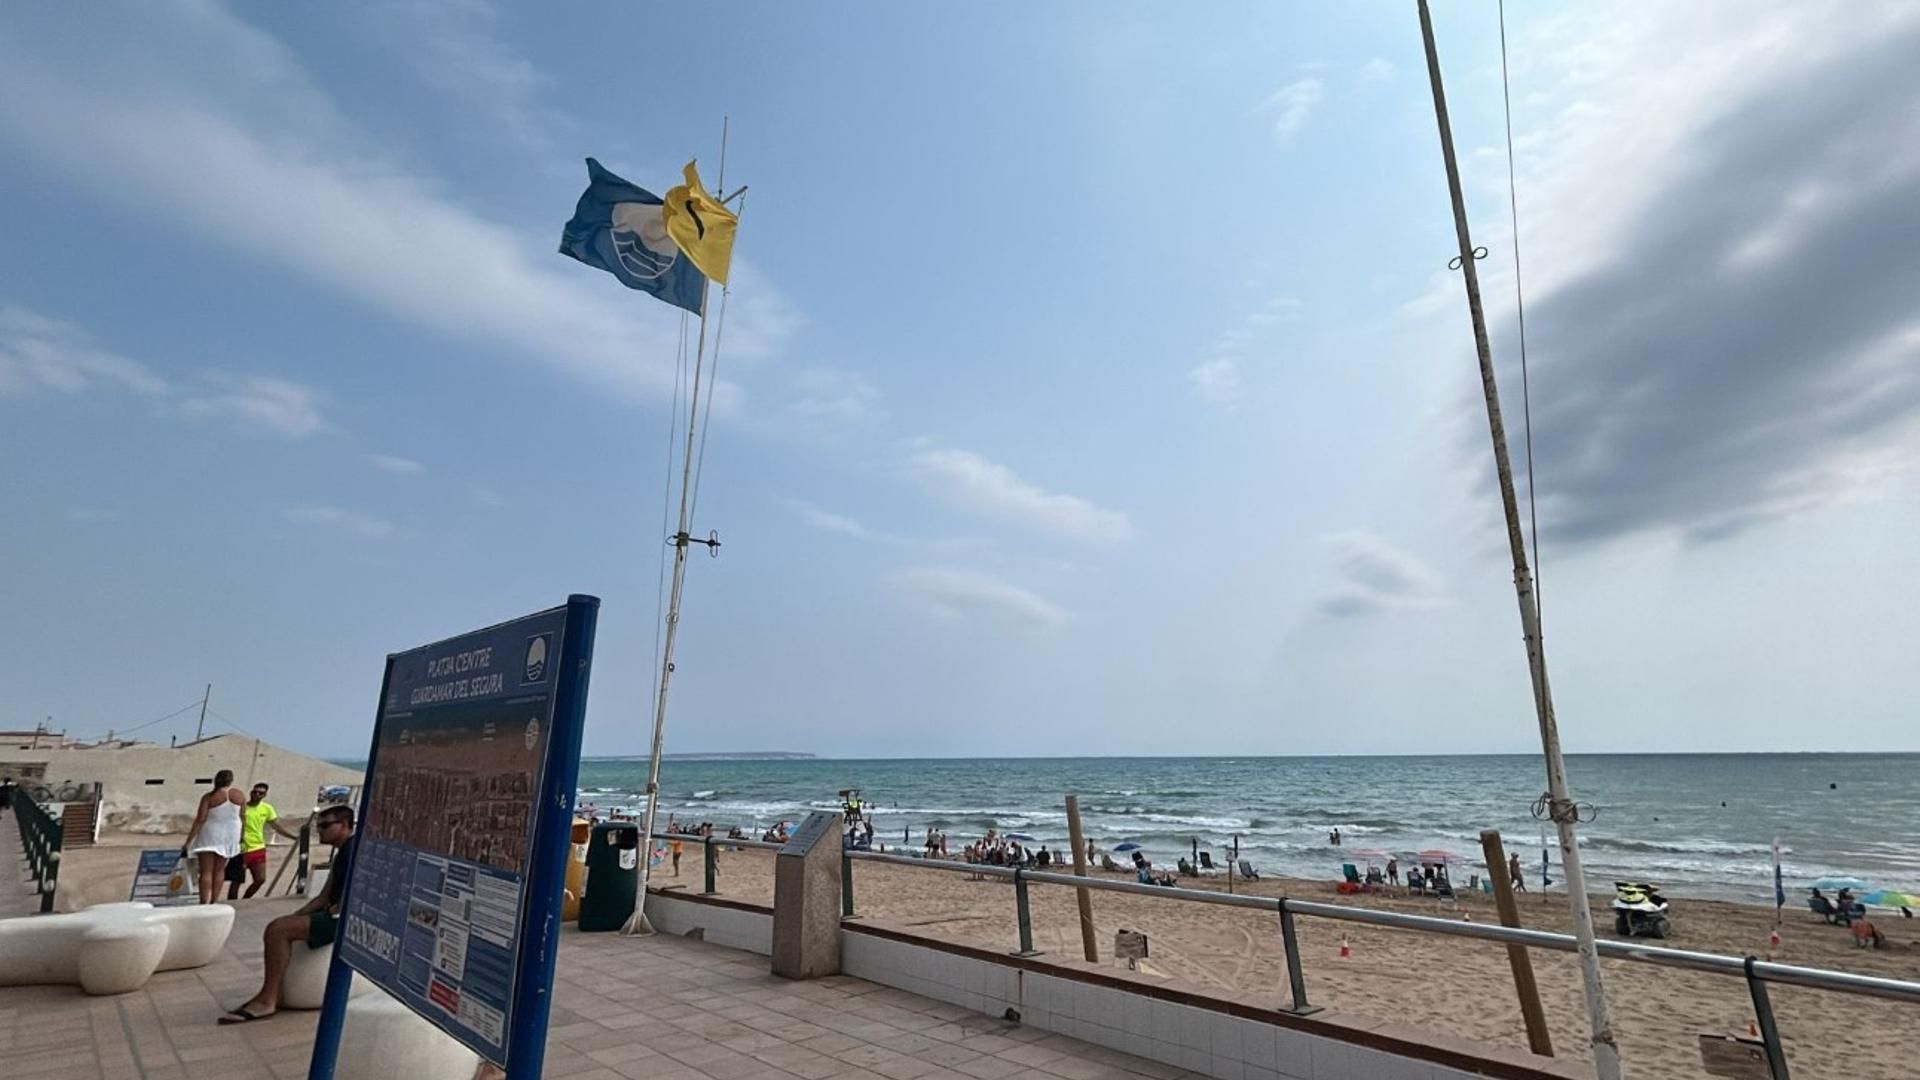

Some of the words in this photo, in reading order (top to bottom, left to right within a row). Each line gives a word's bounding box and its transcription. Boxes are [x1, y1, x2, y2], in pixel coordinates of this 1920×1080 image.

[428, 656, 454, 677] PLATJA
[455, 647, 492, 673] CENTRE
[411, 682, 454, 705] GUARDAMAR
[454, 679, 469, 699] DEL
[470, 673, 504, 697] SEGURA
